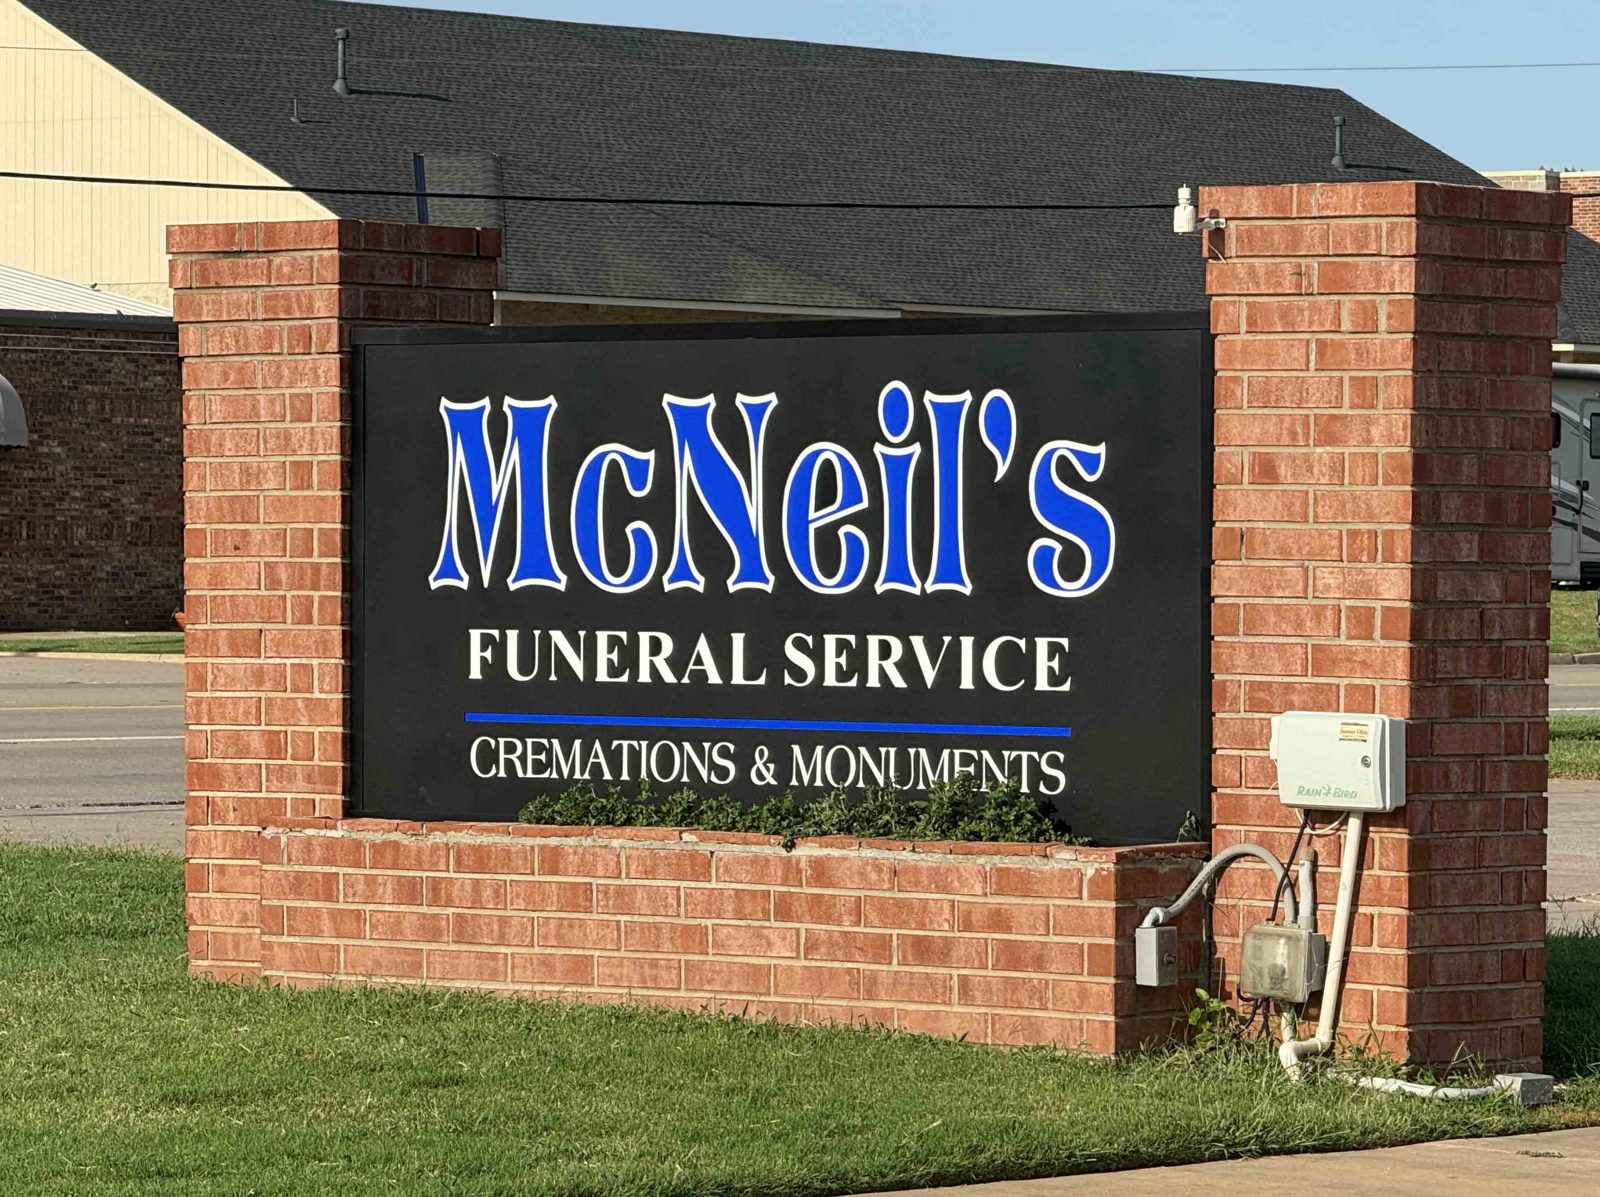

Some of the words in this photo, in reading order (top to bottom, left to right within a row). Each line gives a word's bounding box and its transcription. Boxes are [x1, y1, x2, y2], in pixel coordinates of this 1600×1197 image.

[427, 379, 1116, 598] McNeil's
[468, 628, 767, 686] FUNERAL
[783, 632, 1072, 692] SERVICE
[469, 735, 736, 785] CREMATIONS
[750, 745, 777, 786] &
[788, 744, 1067, 795] MONUMENTS
